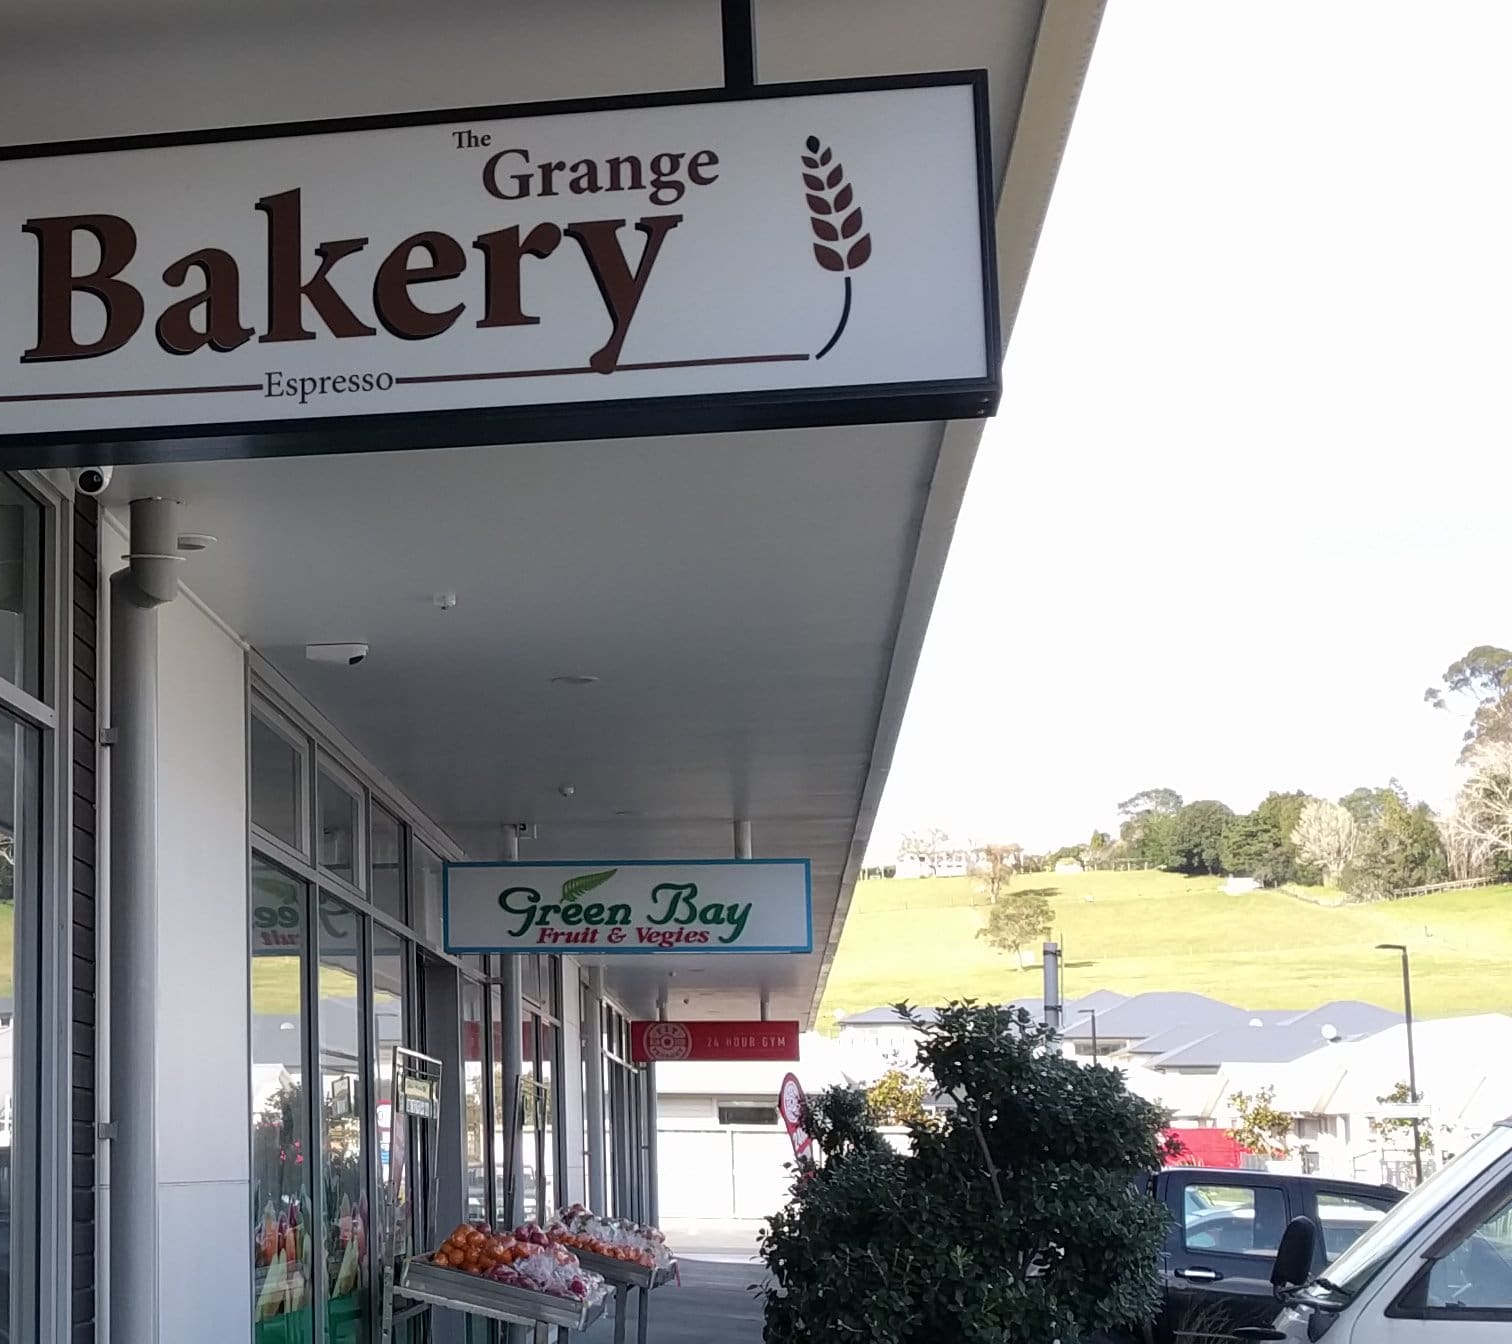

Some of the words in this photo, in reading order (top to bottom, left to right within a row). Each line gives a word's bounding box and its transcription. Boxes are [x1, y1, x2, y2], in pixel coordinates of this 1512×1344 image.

[453, 129, 492, 149] The
[483, 149, 719, 206] Grange
[20, 187, 683, 375] Bakery
[264, 370, 394, 404] Espresso
[498, 886, 631, 937] Green
[646, 882, 753, 943] Bay
[535, 927, 599, 944] Fruit
[607, 927, 627, 943] &
[636, 927, 710, 948] Vegies
[706, 1036, 719, 1048] 24
[726, 1036, 756, 1048] HOUR
[761, 1035, 787, 1048] GYM
